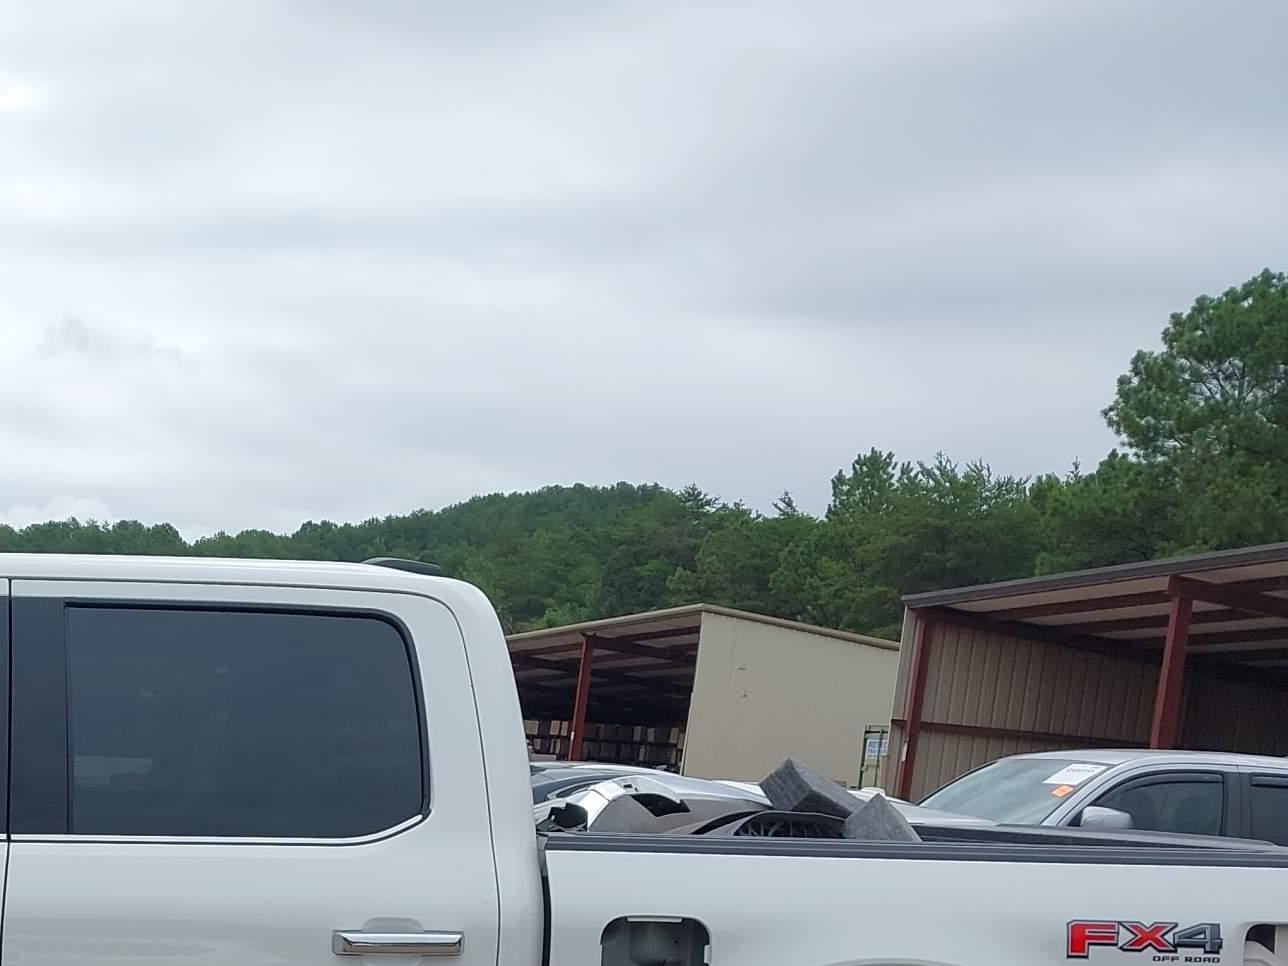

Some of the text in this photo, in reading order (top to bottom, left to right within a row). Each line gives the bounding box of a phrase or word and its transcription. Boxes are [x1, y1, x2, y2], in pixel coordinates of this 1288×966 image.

[1067, 919, 1223, 959] FX4
[1152, 955, 1221, 964] OFF ROAD
